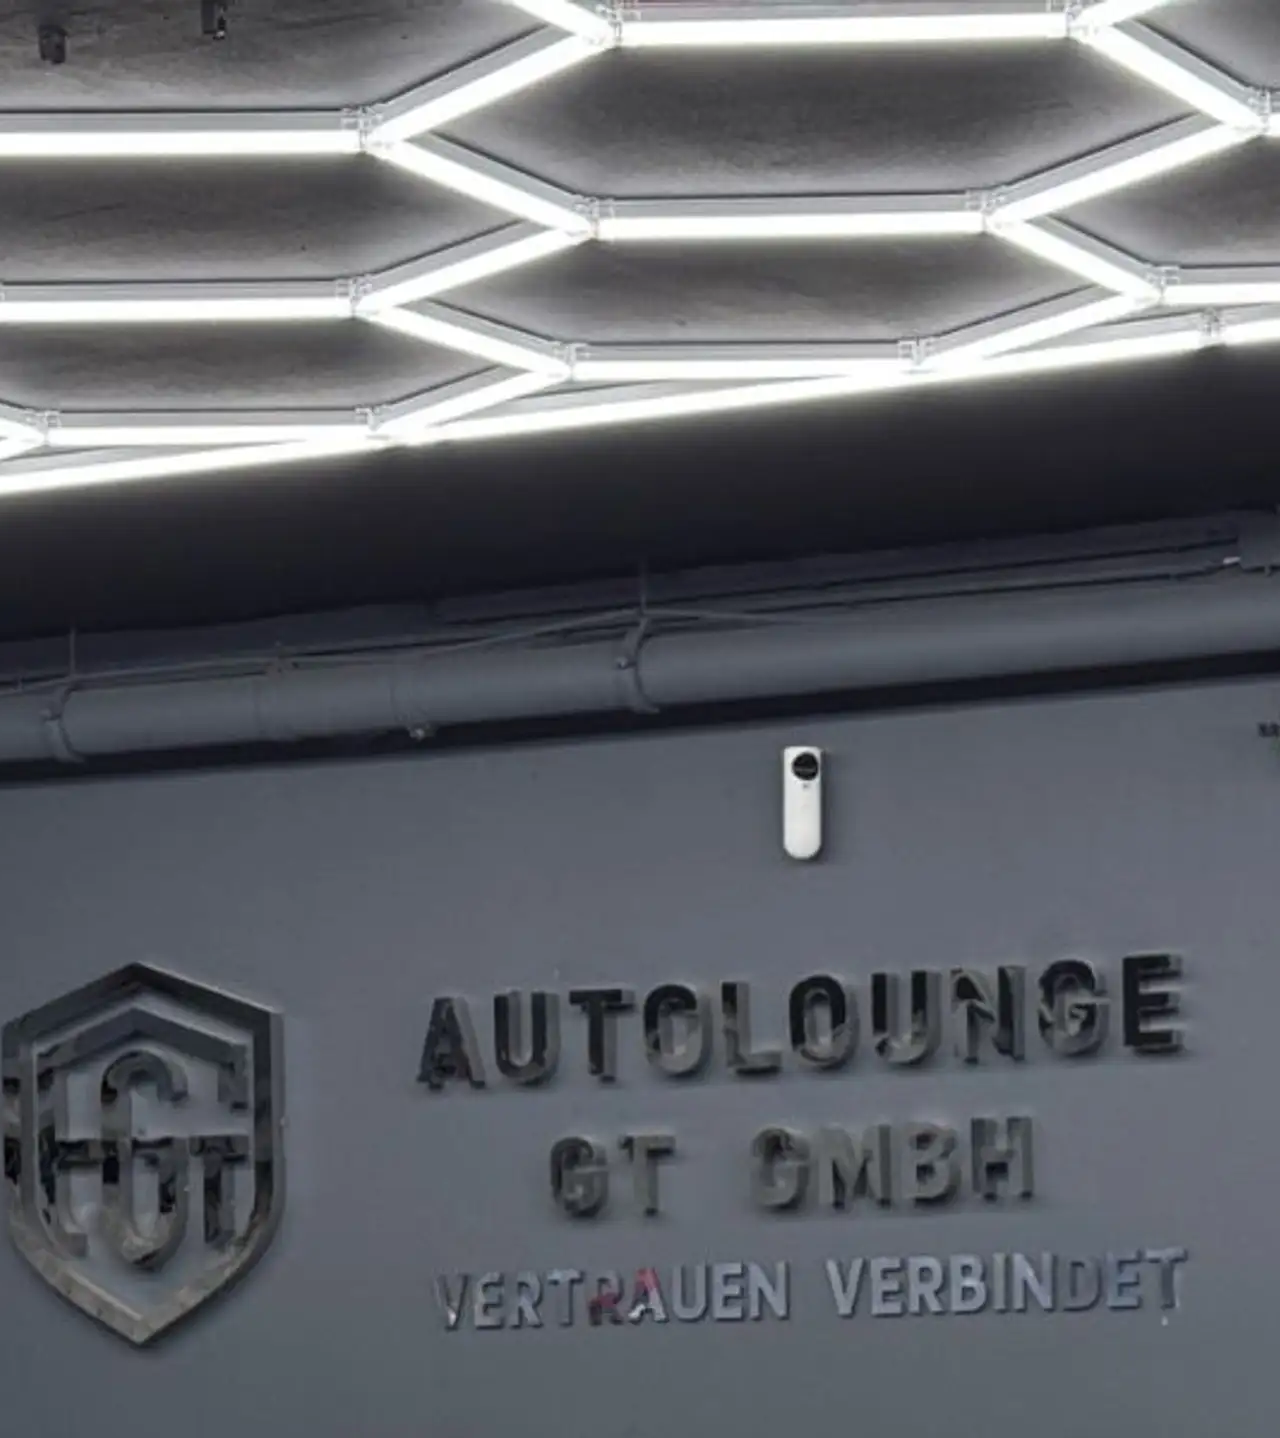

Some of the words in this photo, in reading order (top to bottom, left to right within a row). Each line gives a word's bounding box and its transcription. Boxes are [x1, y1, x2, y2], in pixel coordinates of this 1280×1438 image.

[417, 953, 1187, 1089] AUTOLOUNGE
[549, 1133, 677, 1217] GT
[750, 1115, 1035, 1211] GMBH
[433, 1259, 792, 1331] VERTRAUEN
[825, 1246, 1188, 1319] VERBINDET
